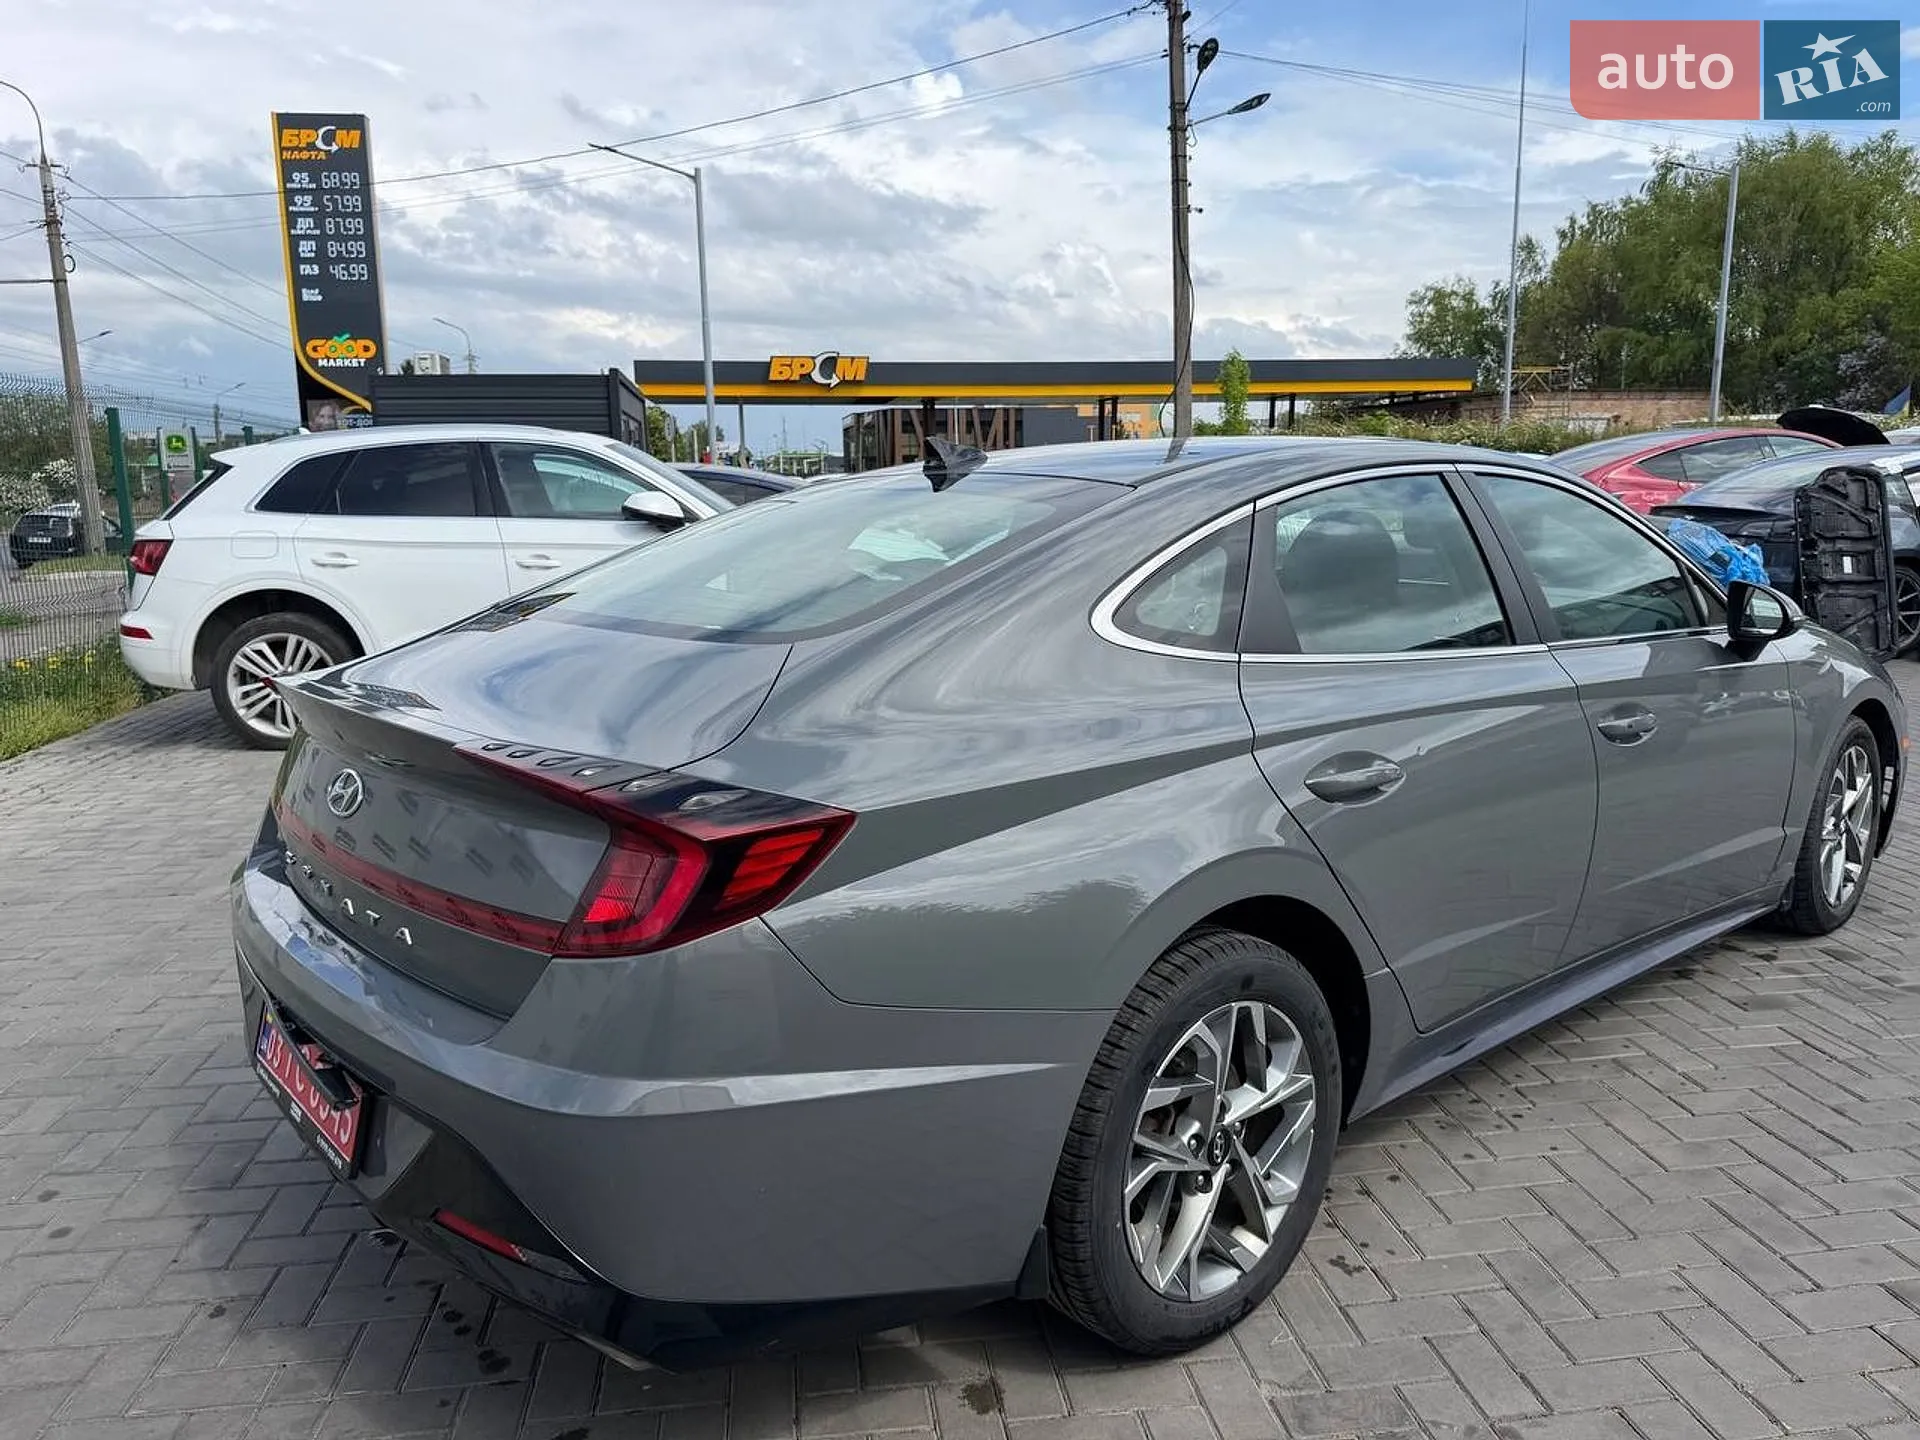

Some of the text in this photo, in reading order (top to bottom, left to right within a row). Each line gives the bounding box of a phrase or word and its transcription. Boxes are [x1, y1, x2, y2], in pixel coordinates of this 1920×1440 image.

[282, 151, 327, 160] НАФТА
[292, 172, 309, 183] 95
[321, 172, 361, 189] 68.99
[294, 195, 313, 207] 95
[323, 195, 362, 212] 57.99
[325, 217, 365, 235] 87.99
[327, 241, 367, 258] 84.99
[299, 263, 369, 280] ГАЗ 46.99
[306, 338, 377, 359] GOOD
[318, 359, 366, 368] MARKET
